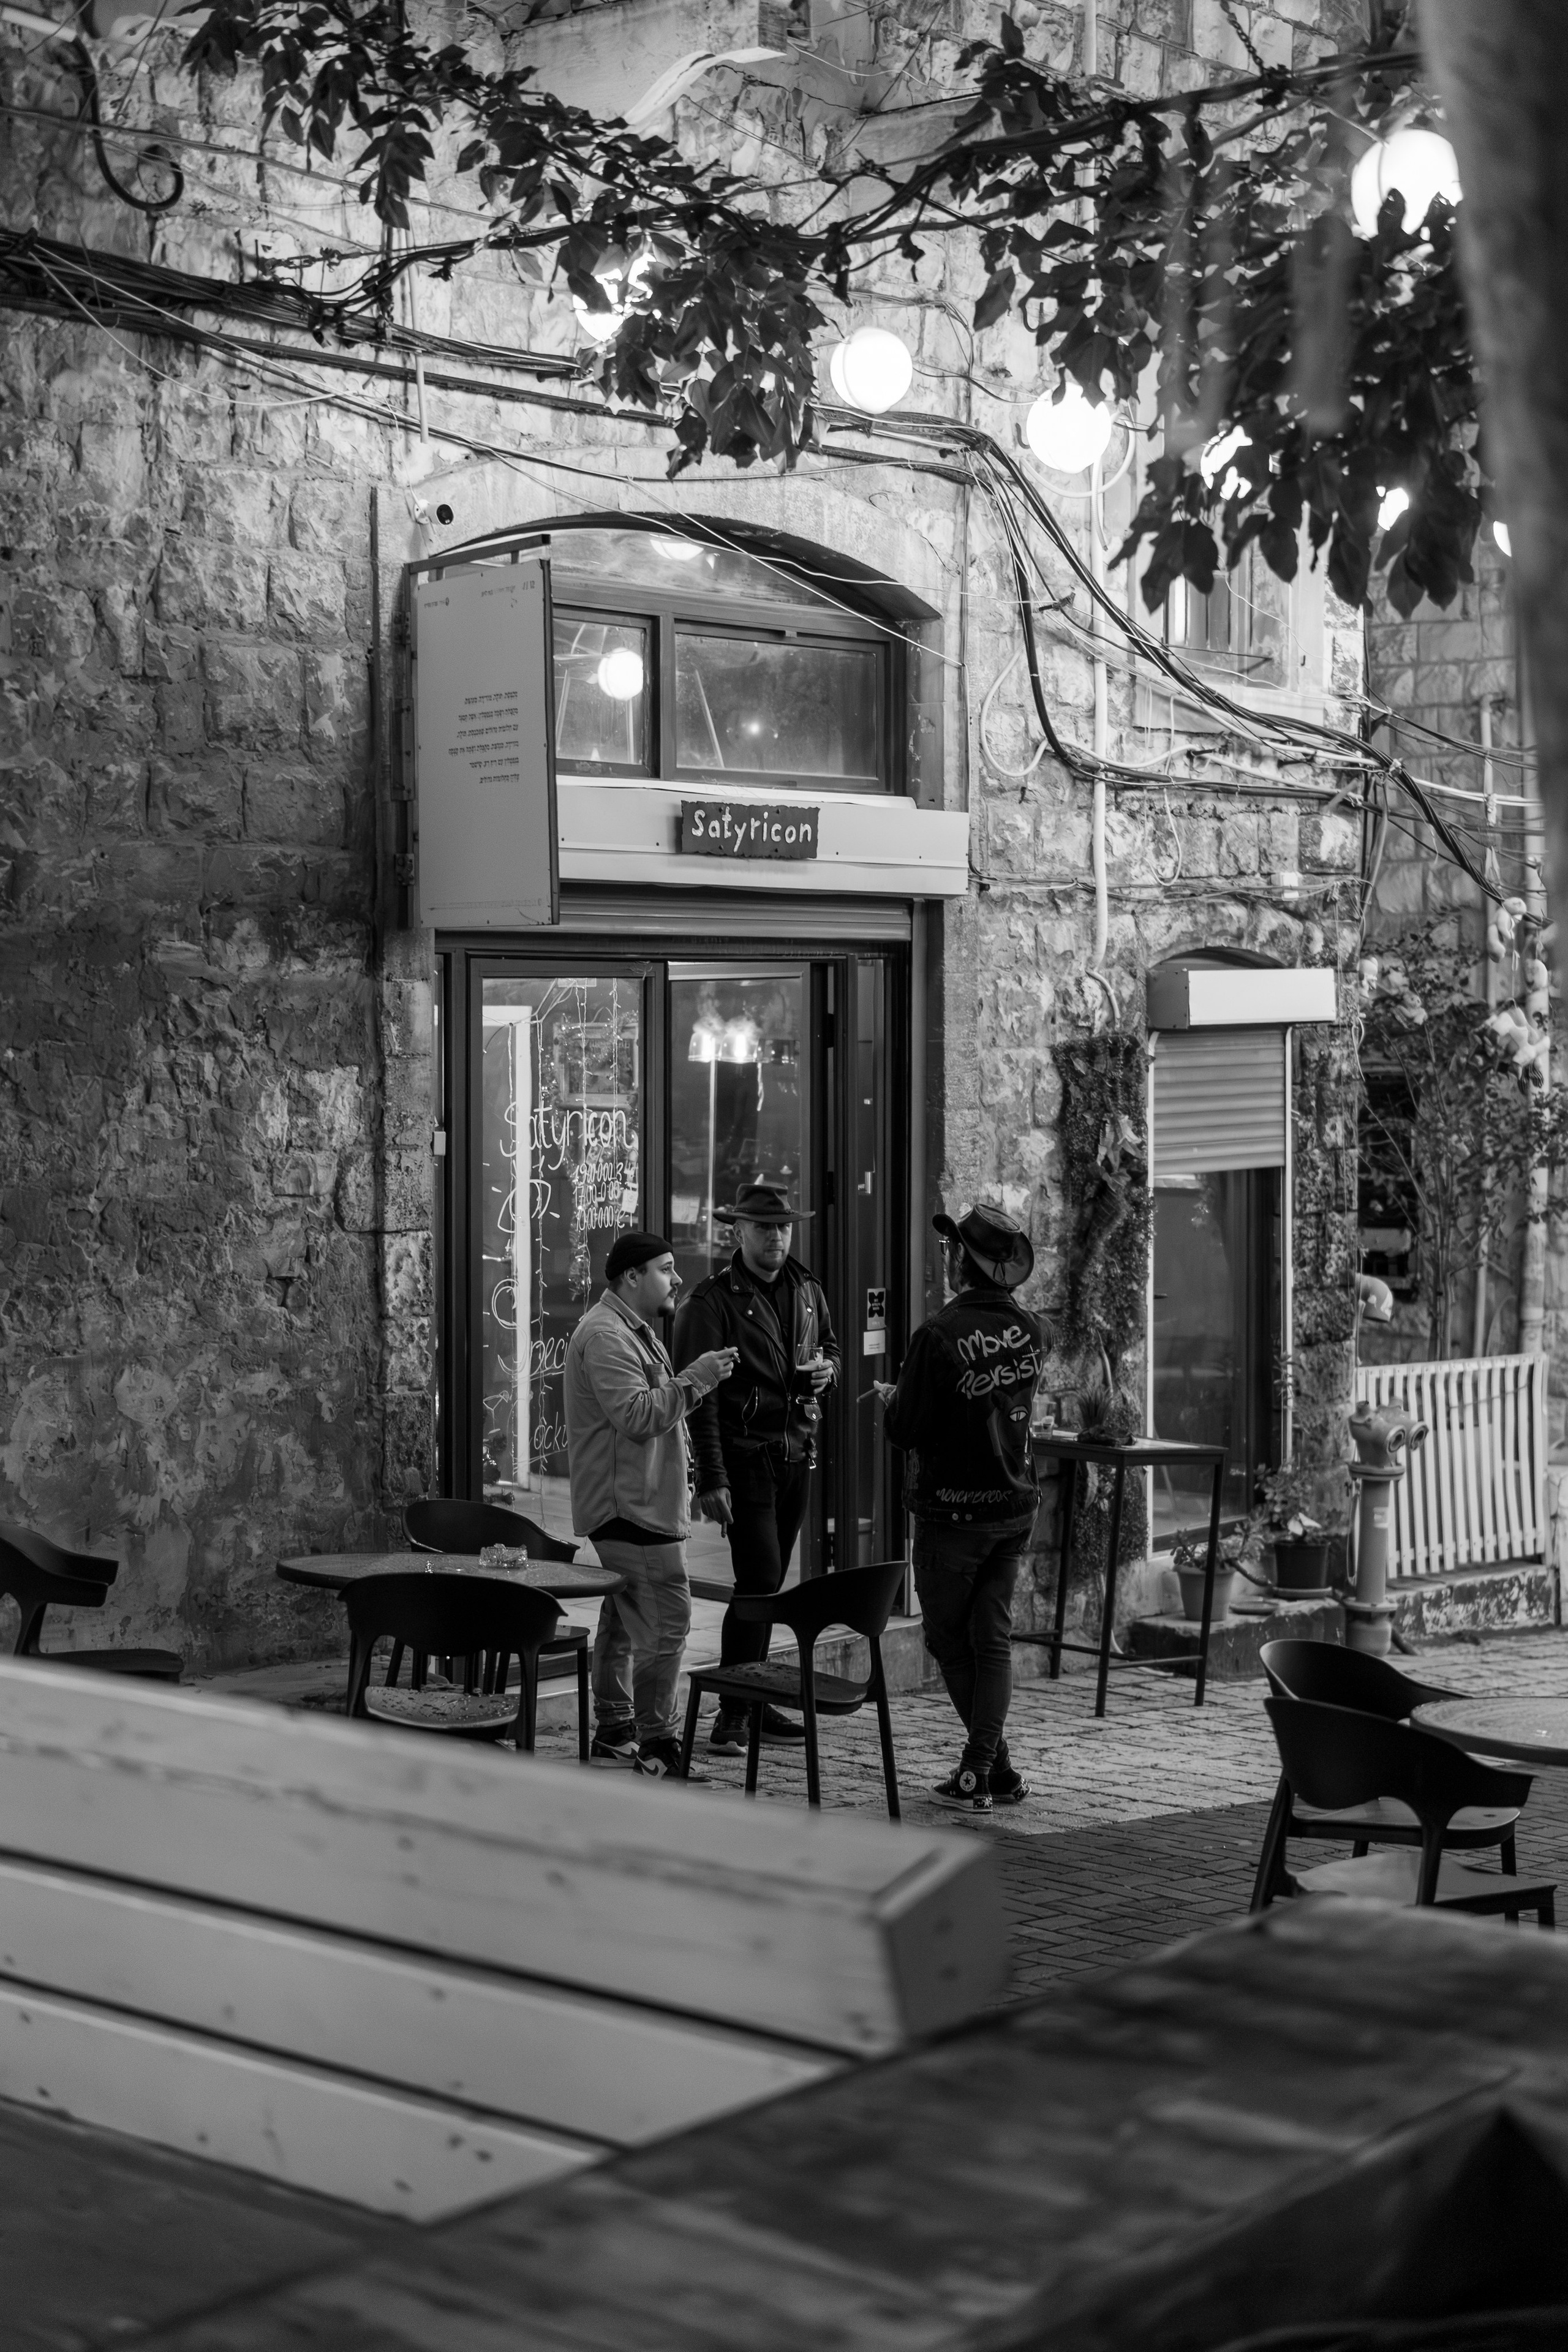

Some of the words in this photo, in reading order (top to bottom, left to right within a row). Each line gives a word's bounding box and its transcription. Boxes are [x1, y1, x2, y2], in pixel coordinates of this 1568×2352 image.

[691, 805, 812, 853] Satyricon
[499, 1099, 633, 1170] Satyricon
[957, 1325, 1031, 1366] Move
